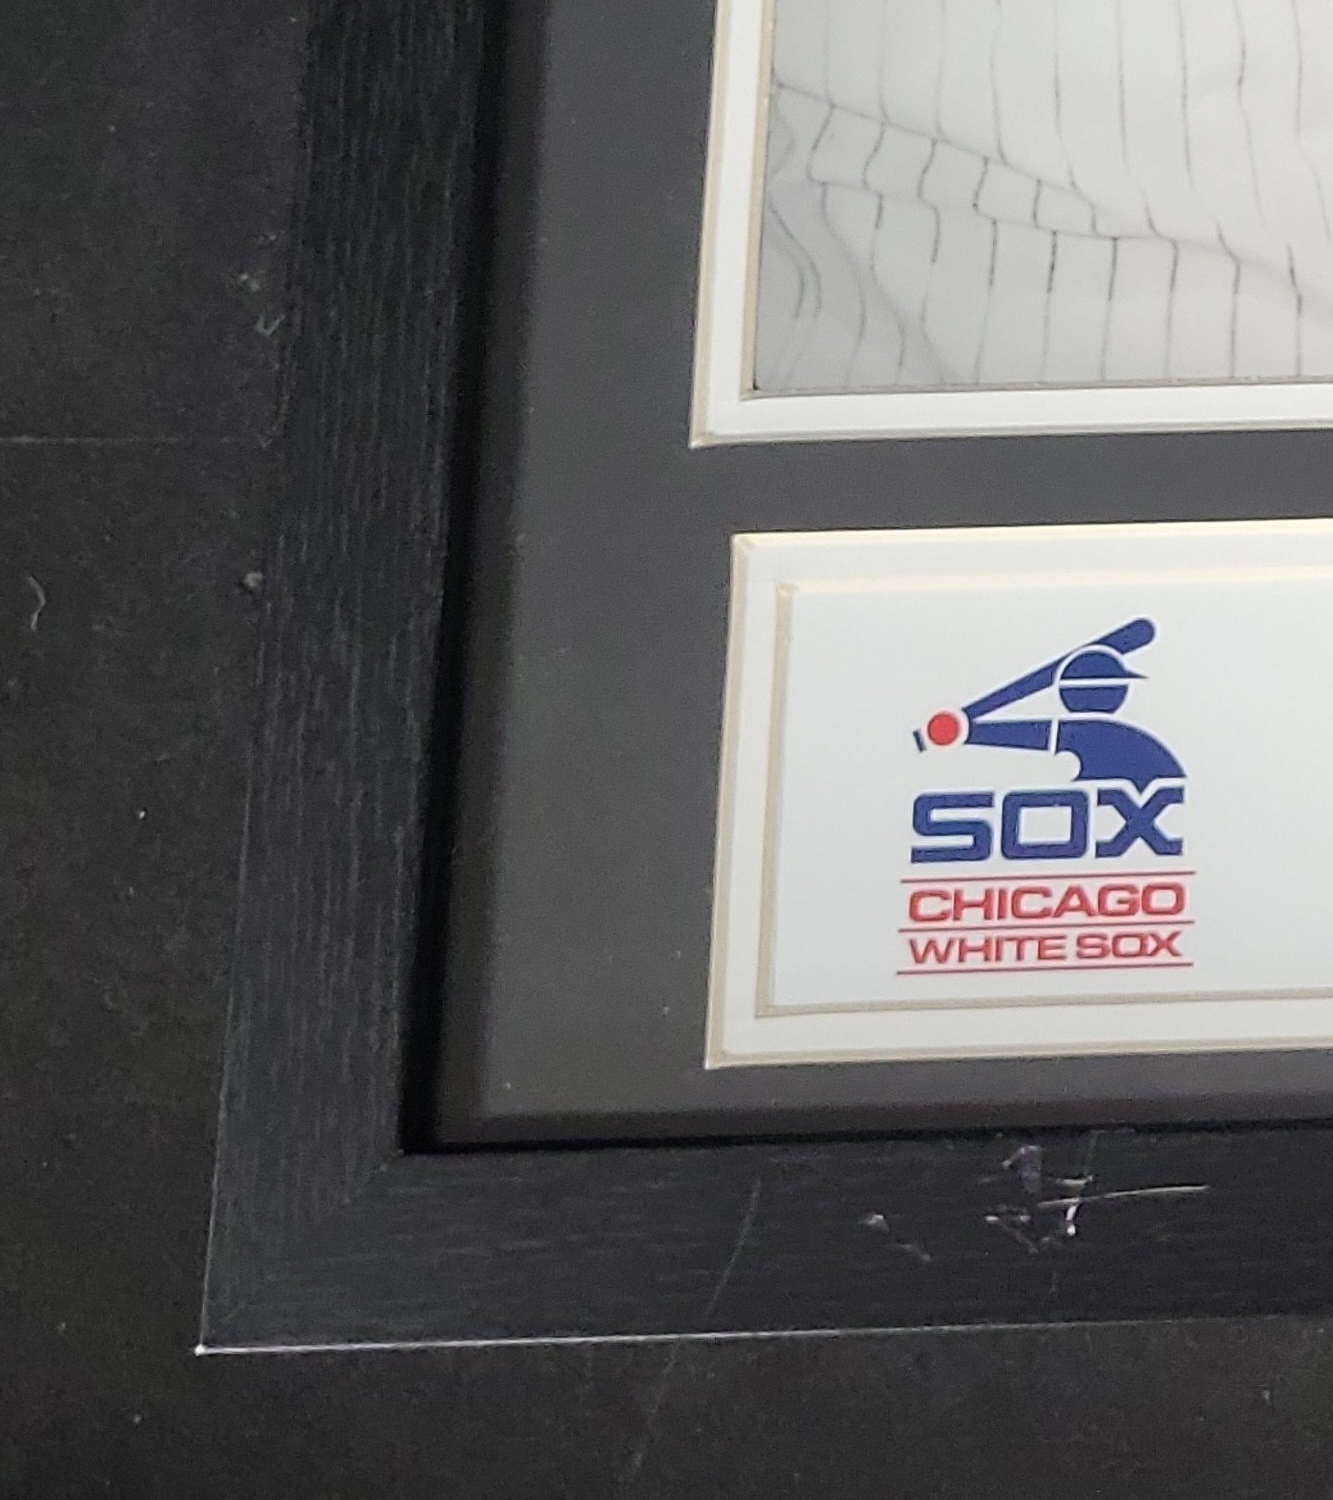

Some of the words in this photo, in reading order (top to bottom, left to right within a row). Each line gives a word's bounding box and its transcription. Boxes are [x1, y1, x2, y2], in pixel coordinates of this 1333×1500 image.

[910, 786, 1186, 864] SOX
[908, 881, 1185, 923] CHICAGO
[908, 933, 1067, 964] WHITE
[1076, 930, 1184, 960] SOX
